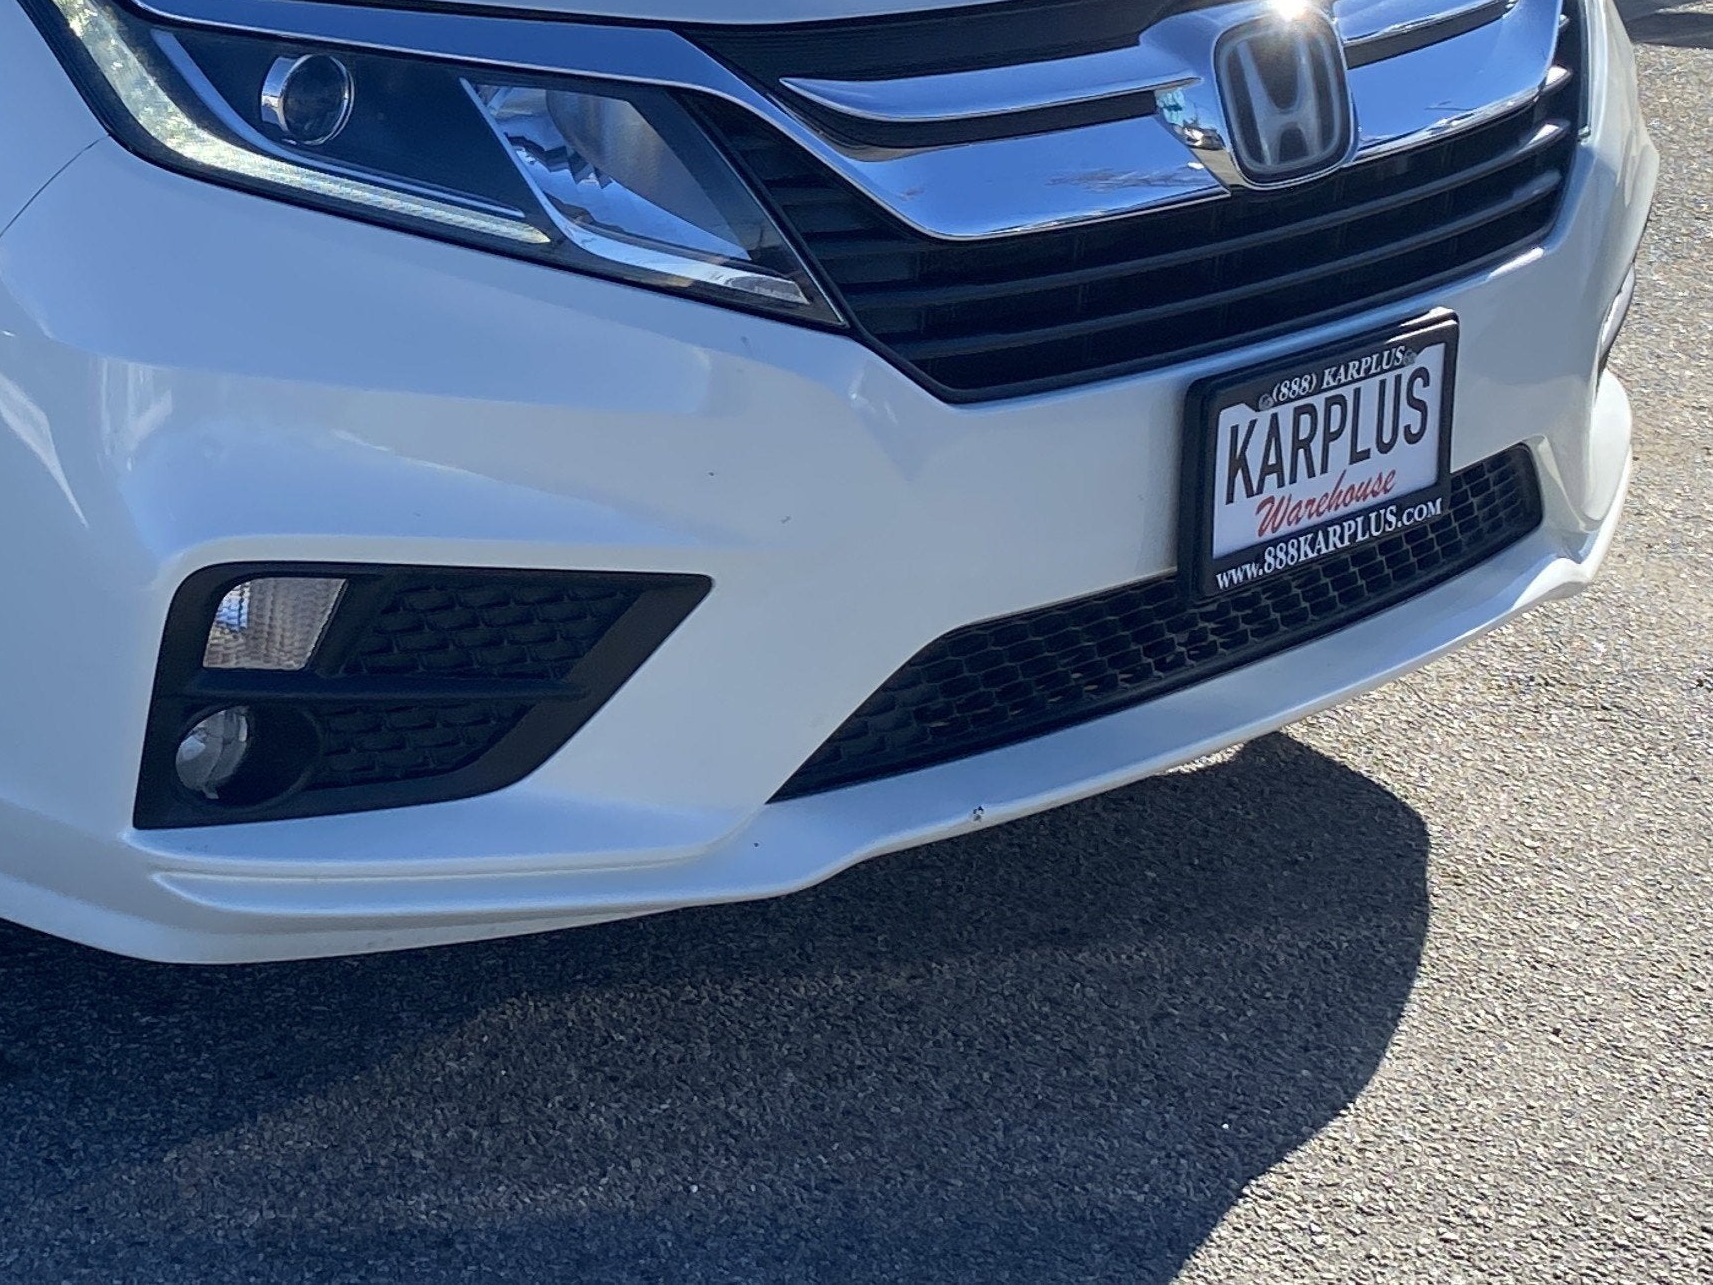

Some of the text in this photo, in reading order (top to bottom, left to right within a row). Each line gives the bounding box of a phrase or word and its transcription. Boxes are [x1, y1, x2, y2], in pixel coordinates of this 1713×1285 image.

[1271, 345, 1405, 402] (888) KARPLUS
[1225, 367, 1431, 506] KARPLUS
[1254, 469, 1397, 538] Warehouse
